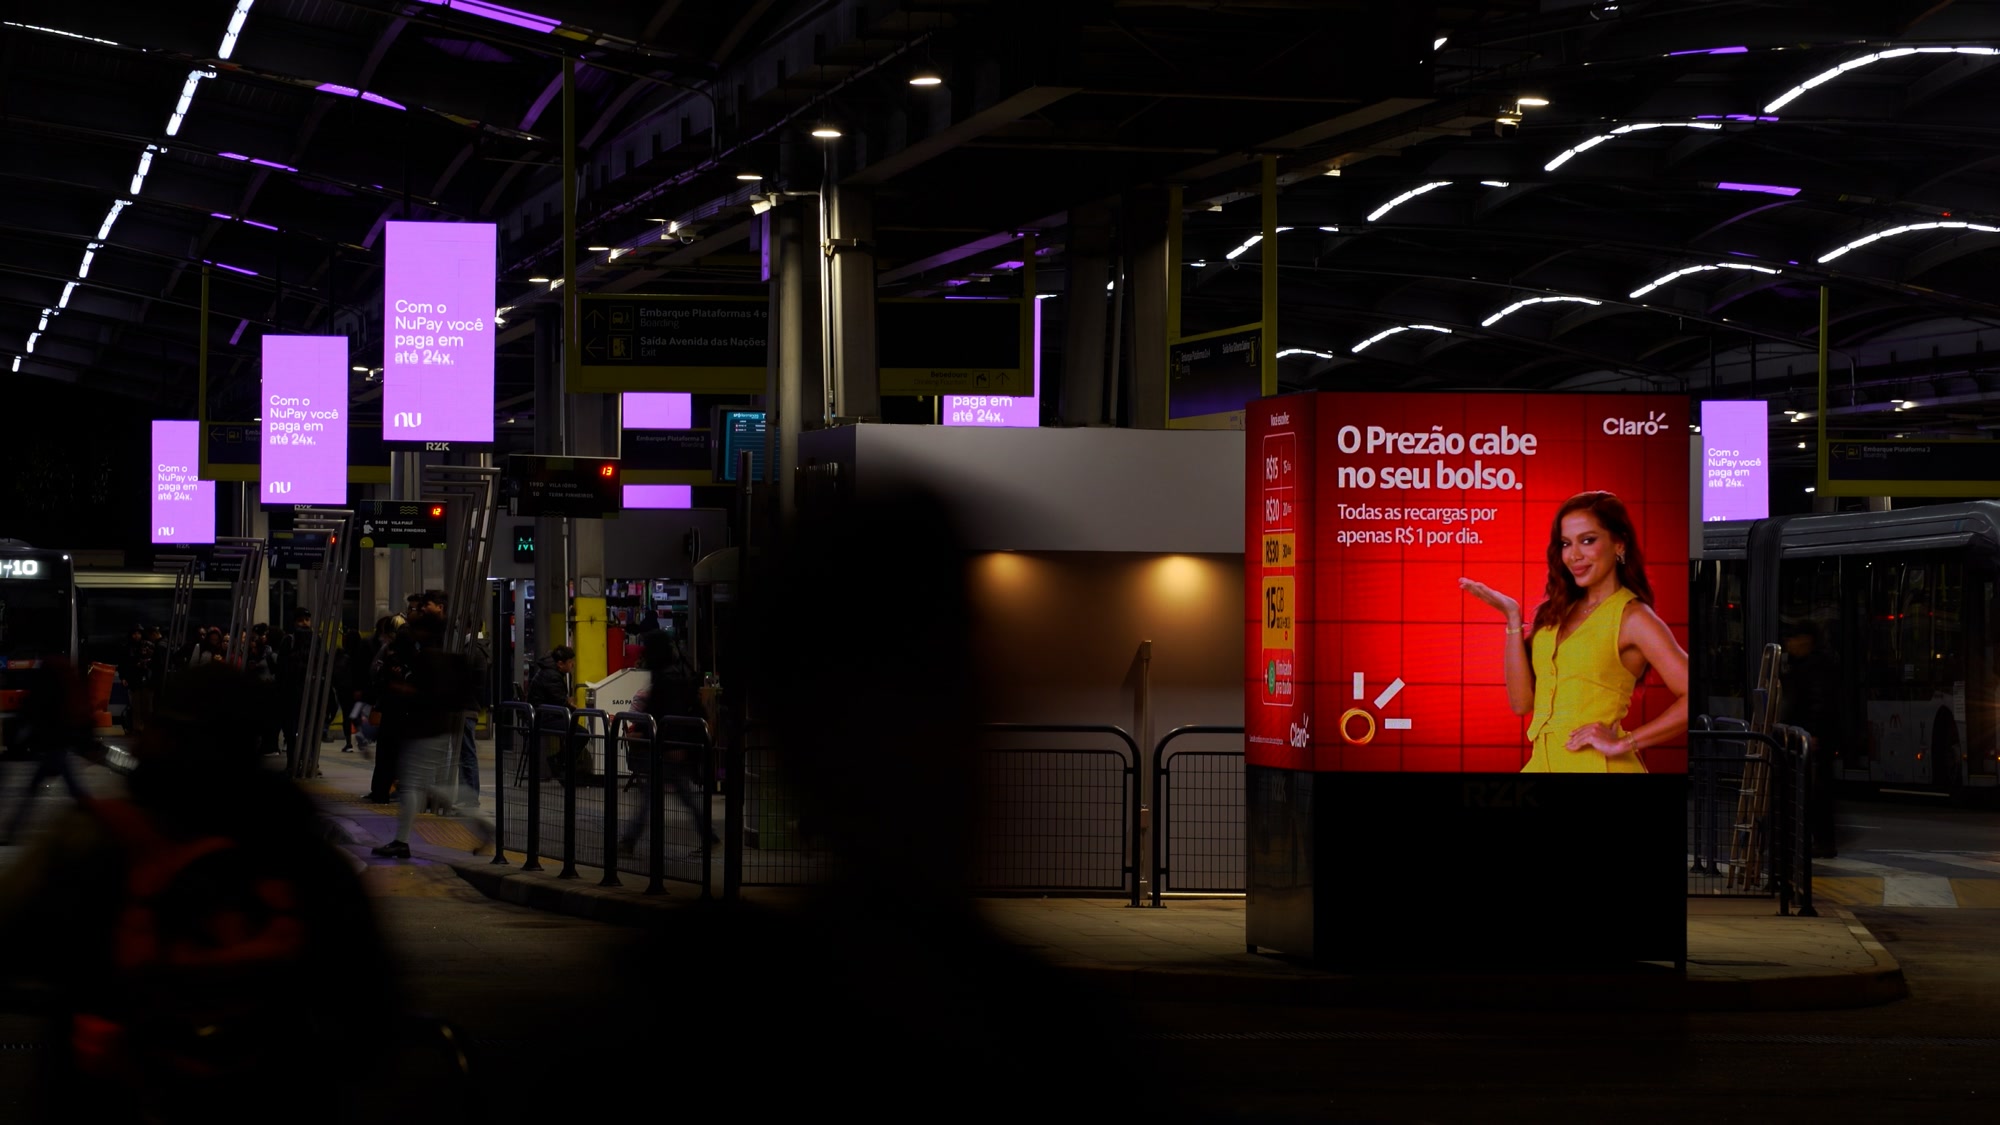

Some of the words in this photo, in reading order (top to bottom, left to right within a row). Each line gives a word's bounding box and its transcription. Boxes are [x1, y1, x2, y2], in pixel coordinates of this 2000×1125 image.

[395, 300, 432, 314] Com
[437, 304, 447, 314] o
[640, 308, 690, 318] Embarque
[692, 308, 752, 318] Plataformas
[753, 310, 760, 318] 4
[395, 316, 444, 333] NuPay
[446, 318, 484, 331] você
[640, 318, 680, 329] Boarding
[395, 335, 434, 349] paga
[438, 336, 464, 346] em
[640, 336, 668, 346] Saída
[670, 337, 708, 346] Avenida
[712, 338, 728, 346] das
[730, 338, 767, 349] Nações
[394, 350, 419, 365] até
[423, 350, 454, 365] 24x.
[641, 349, 656, 357] Exit
[270, 395, 299, 406] Com
[302, 398, 310, 406] o
[952, 396, 986, 409] paga
[990, 397, 1012, 407] em
[270, 408, 307, 421] NuPay
[310, 409, 339, 419] você
[952, 409, 974, 422] até
[977, 409, 1004, 423] 24x.
[270, 422, 300, 433] paga
[304, 423, 323, 431] em
[1602, 412, 1668, 436] Claro
[270, 433, 288, 445] até
[291, 433, 316, 445] 24x.
[1337, 425, 1361, 454] O
[1367, 425, 1465, 455] Prezão
[1469, 426, 1538, 456] cabe
[426, 442, 450, 451] RZK
[1708, 448, 1731, 456] Com
[158, 464, 180, 472] Com
[1708, 458, 1737, 468] NuPay
[1739, 458, 1761, 466] você
[602, 466, 613, 476] 13
[1337, 465, 1376, 490] no
[1380, 466, 1430, 490] seu
[1436, 460, 1523, 490] bolso.
[1708, 469, 1732, 478] paga
[158, 474, 186, 483] NuPay
[1708, 478, 1723, 488] até
[1725, 478, 1744, 488] 24x.
[158, 484, 181, 492] paga
[158, 492, 172, 500] até
[174, 492, 192, 501] 24x.
[1266, 496, 1280, 524] R$20
[1337, 504, 1382, 520] Todas
[1384, 508, 1402, 520] as
[1404, 508, 1468, 525] recargas
[1470, 508, 1498, 524] por
[1337, 530, 1393, 547] apenas
[1426, 530, 1453, 548] por
[1455, 528, 1483, 544] dia.
[0, 560, 38, 576] -10
[1266, 587, 1276, 628] 15
[1290, 718, 1308, 748] Claro
